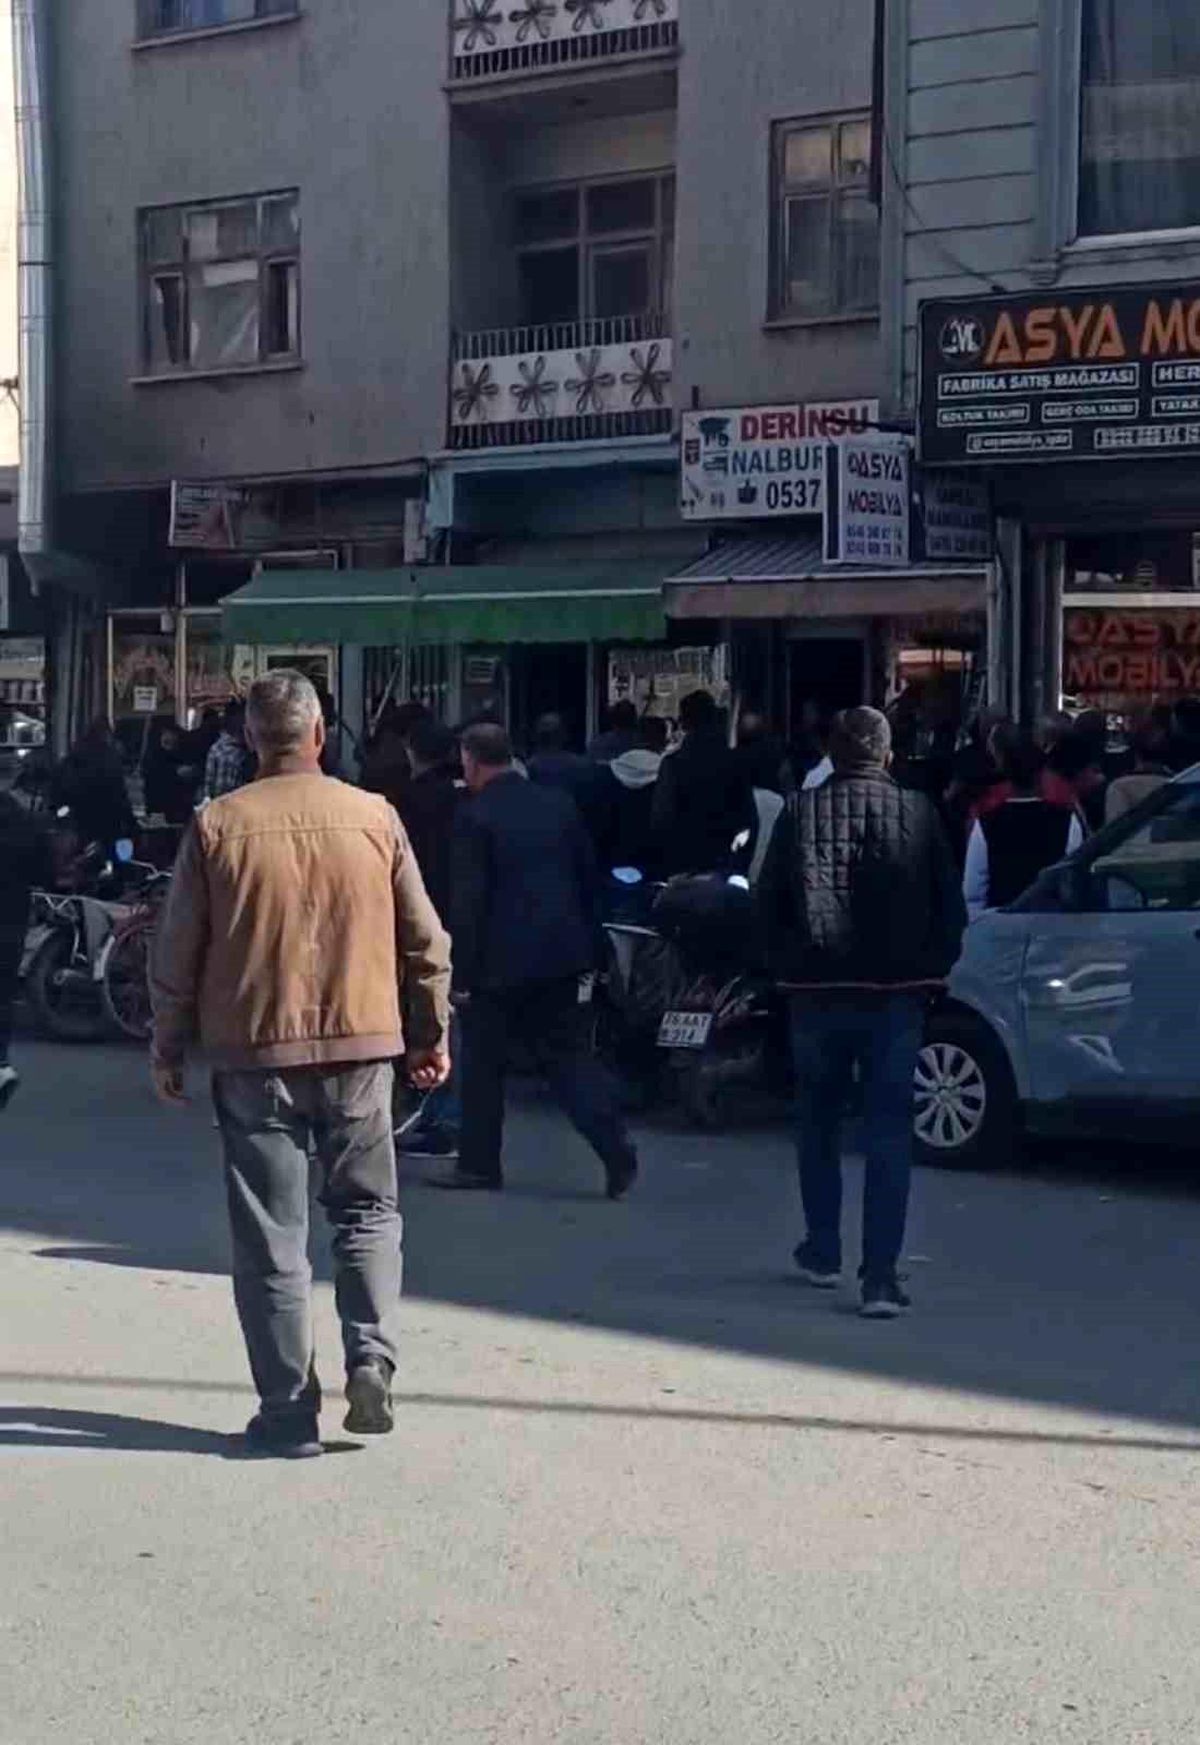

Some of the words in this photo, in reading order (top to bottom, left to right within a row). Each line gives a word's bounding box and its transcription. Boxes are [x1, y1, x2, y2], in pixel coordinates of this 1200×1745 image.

[984, 304, 1126, 364] ASYA
[1054, 370, 1135, 388] MAĞAZASI
[767, 479, 821, 510] 0537
